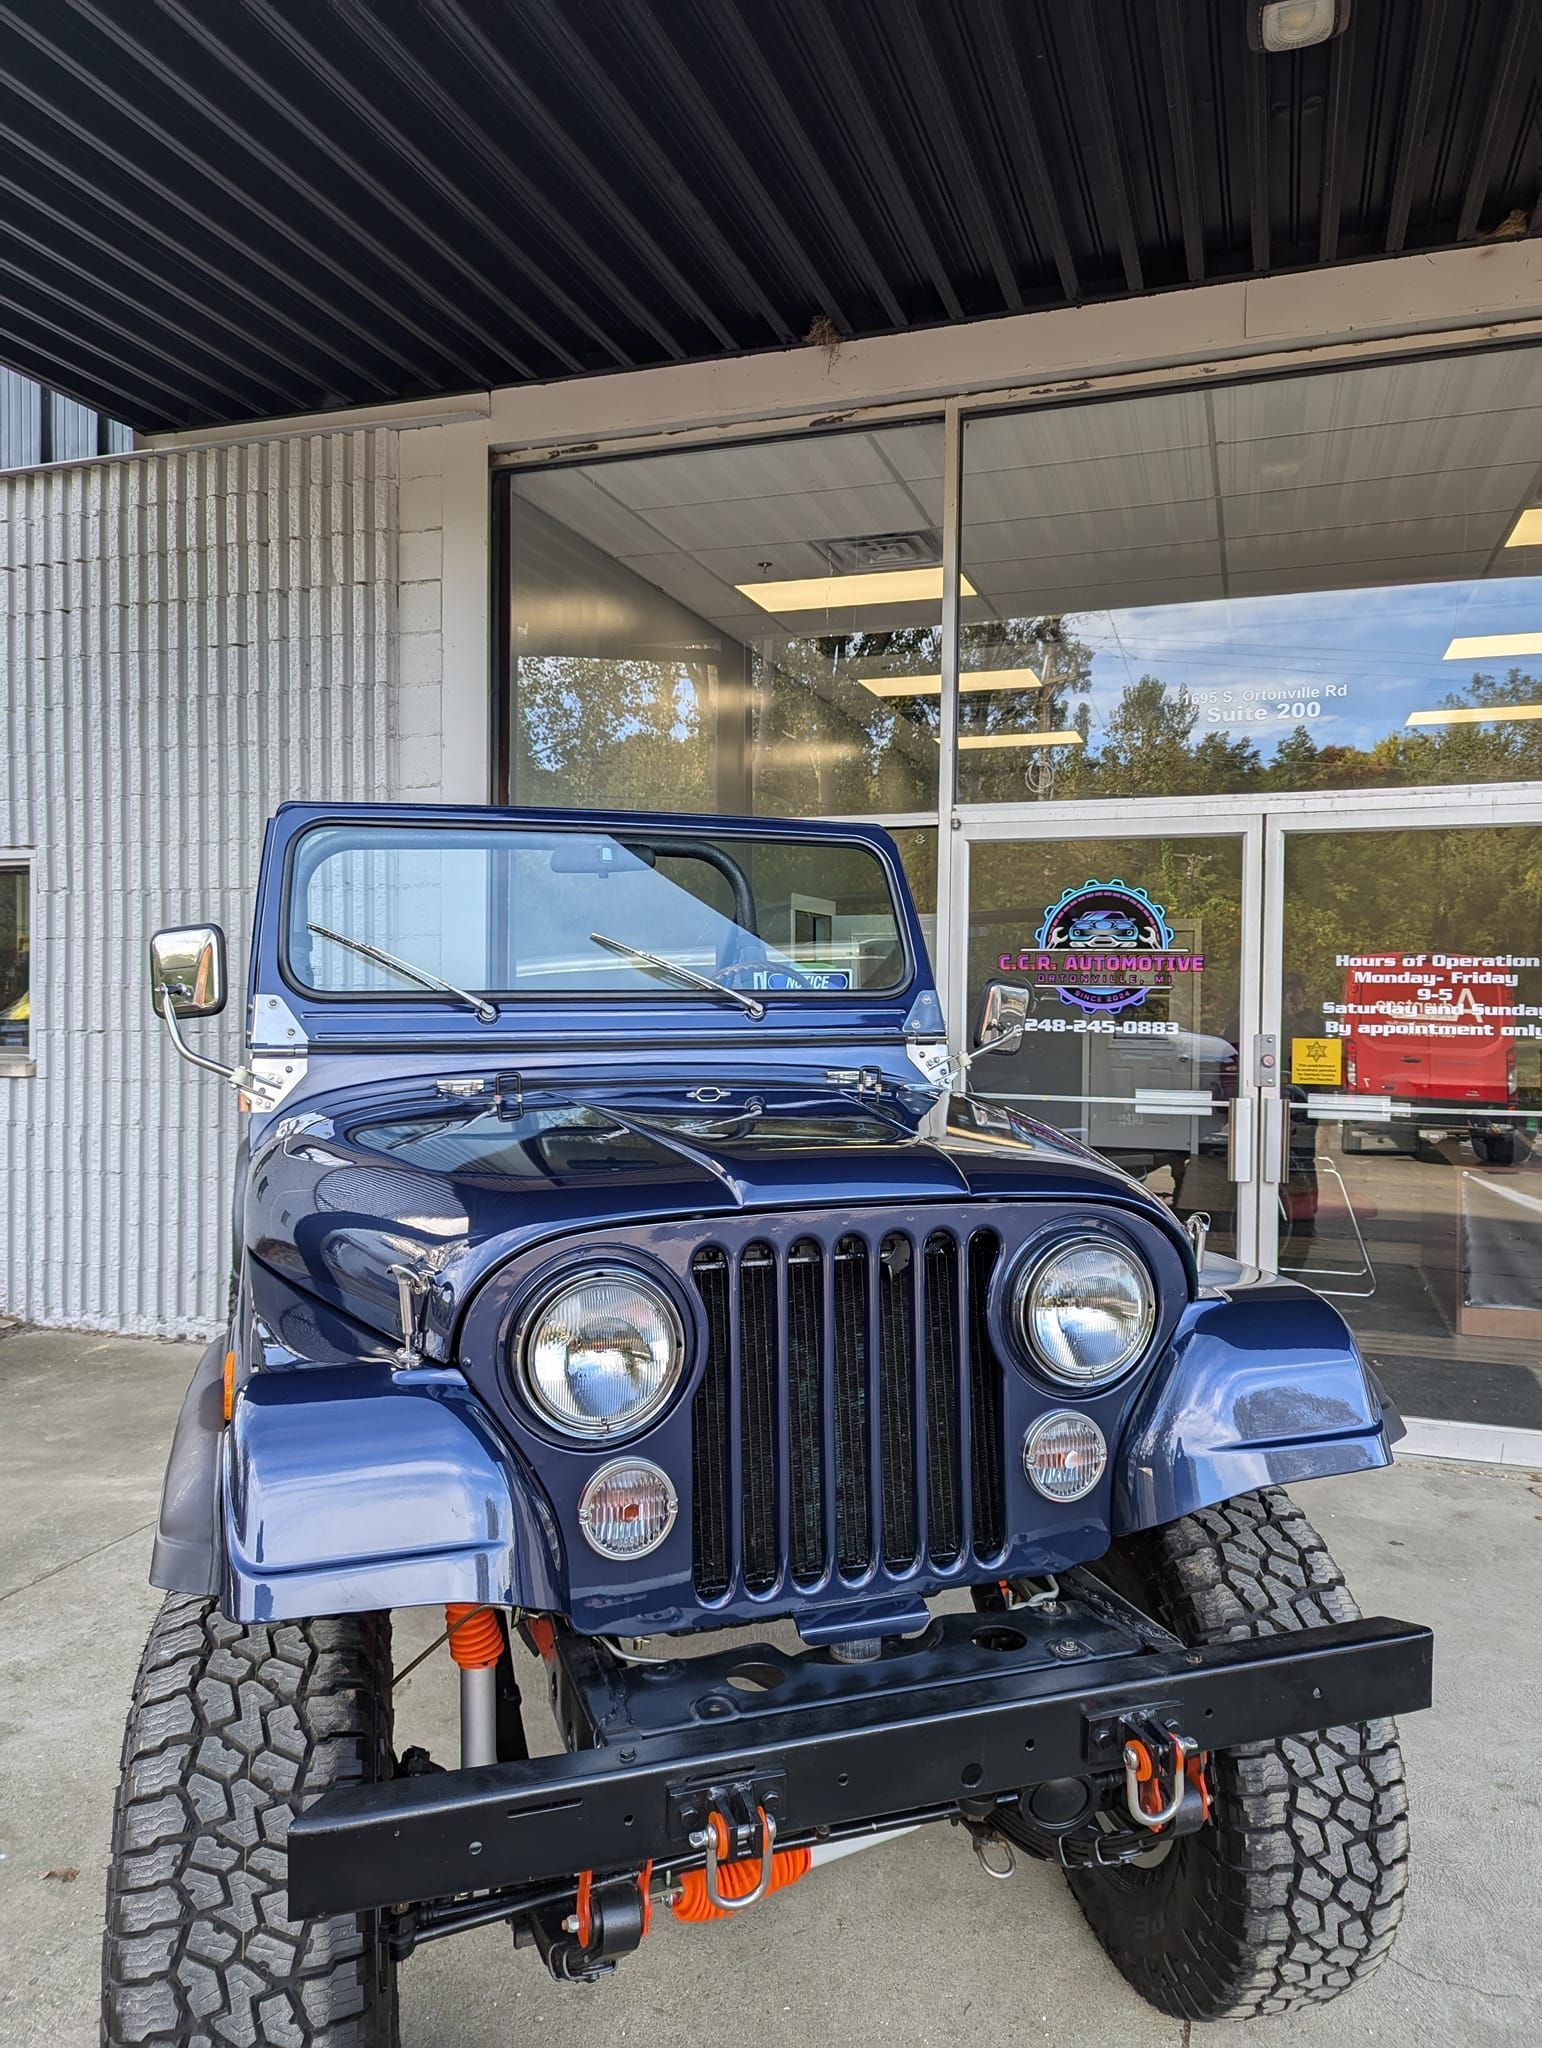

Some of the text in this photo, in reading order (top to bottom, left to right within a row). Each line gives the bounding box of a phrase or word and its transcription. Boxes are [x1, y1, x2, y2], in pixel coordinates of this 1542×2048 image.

[1183, 691, 1218, 705] 1695
[1243, 686, 1320, 702] Ortonville
[1325, 684, 1347, 697] Rd
[1207, 701, 1321, 723] Suite 200
[998, 953, 1206, 972] C.C.R. AUTOMOTIVE
[1335, 954, 1540, 970] Hours of Operation
[1037, 974, 1173, 986] ORTONVILLE, MI
[1354, 971, 1519, 987] Monday- Friday
[1073, 989, 1131, 1003] SINCE 2024
[1417, 988, 1454, 1001] 9-5
[1322, 1001, 1542, 1020] Saturday and Sunda
[1024, 1018, 1179, 1036] 248-245-0883
[1325, 1021, 1352, 1037] By
[1357, 1022, 1495, 1037] appointment
